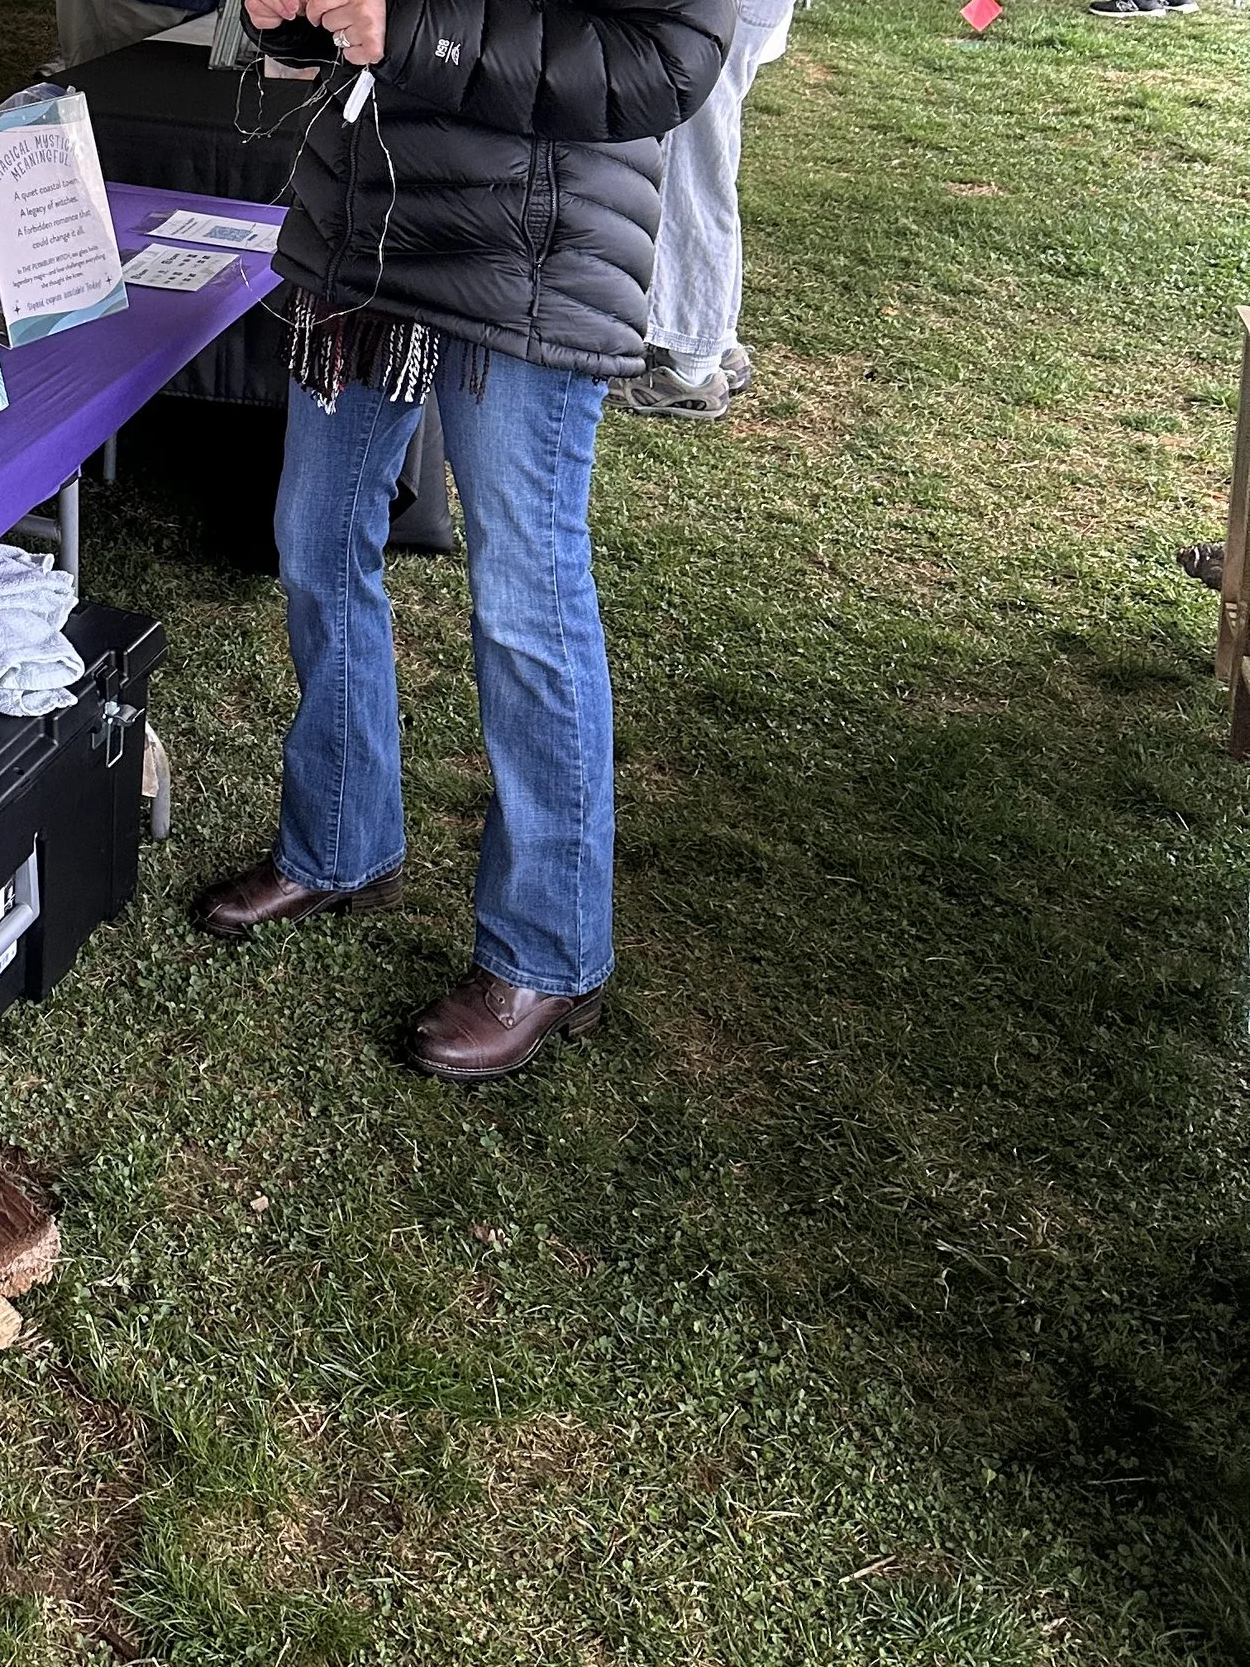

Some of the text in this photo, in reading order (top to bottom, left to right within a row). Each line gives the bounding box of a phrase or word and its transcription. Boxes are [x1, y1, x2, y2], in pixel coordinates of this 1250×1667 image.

[435, 38, 449, 58] 850
[14, 191, 21, 202] A
[21, 187, 39, 203] quiet
[40, 180, 61, 195] coastal
[20, 207, 26, 218] A
[26, 202, 46, 218] legacy
[47, 200, 54, 210] of
[17, 209, 91, 238] A forbidden romance that
[32, 237, 50, 250] could
[49, 231, 70, 246] change
[70, 229, 77, 238] it
